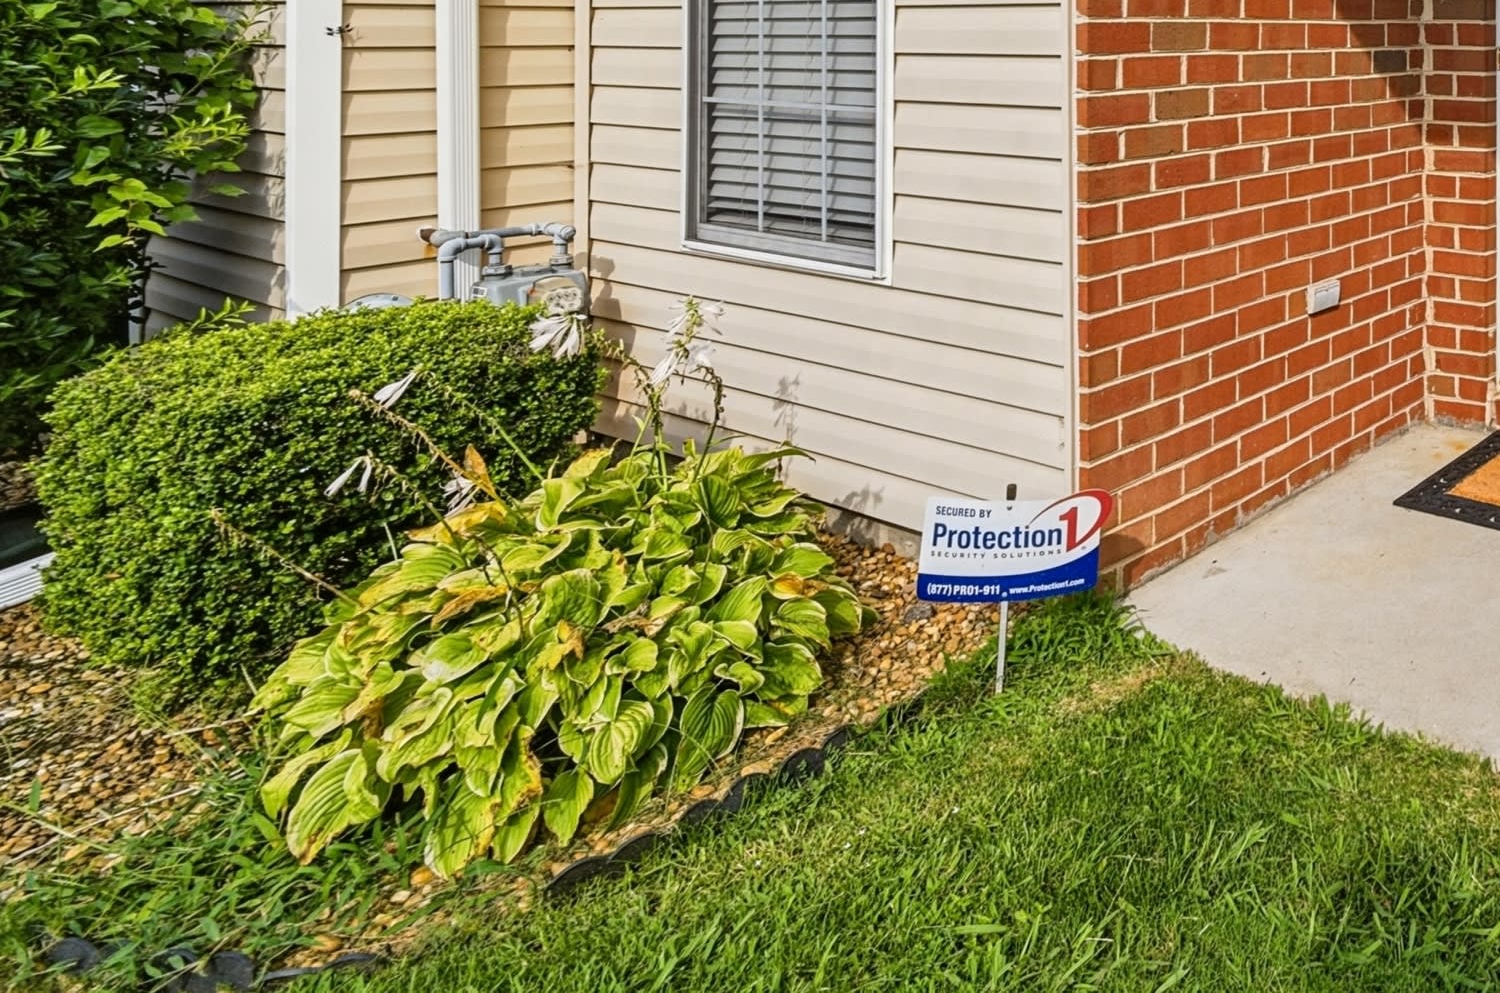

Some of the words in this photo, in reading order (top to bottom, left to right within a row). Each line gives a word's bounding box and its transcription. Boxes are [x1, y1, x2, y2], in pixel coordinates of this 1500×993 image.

[936, 506, 976, 518] SECURED
[979, 509, 992, 519] BY
[931, 550, 986, 559] SECURITY
[993, 549, 1062, 559] SOLUTIONS
[1009, 578, 1085, 595] www.Protection1.com
